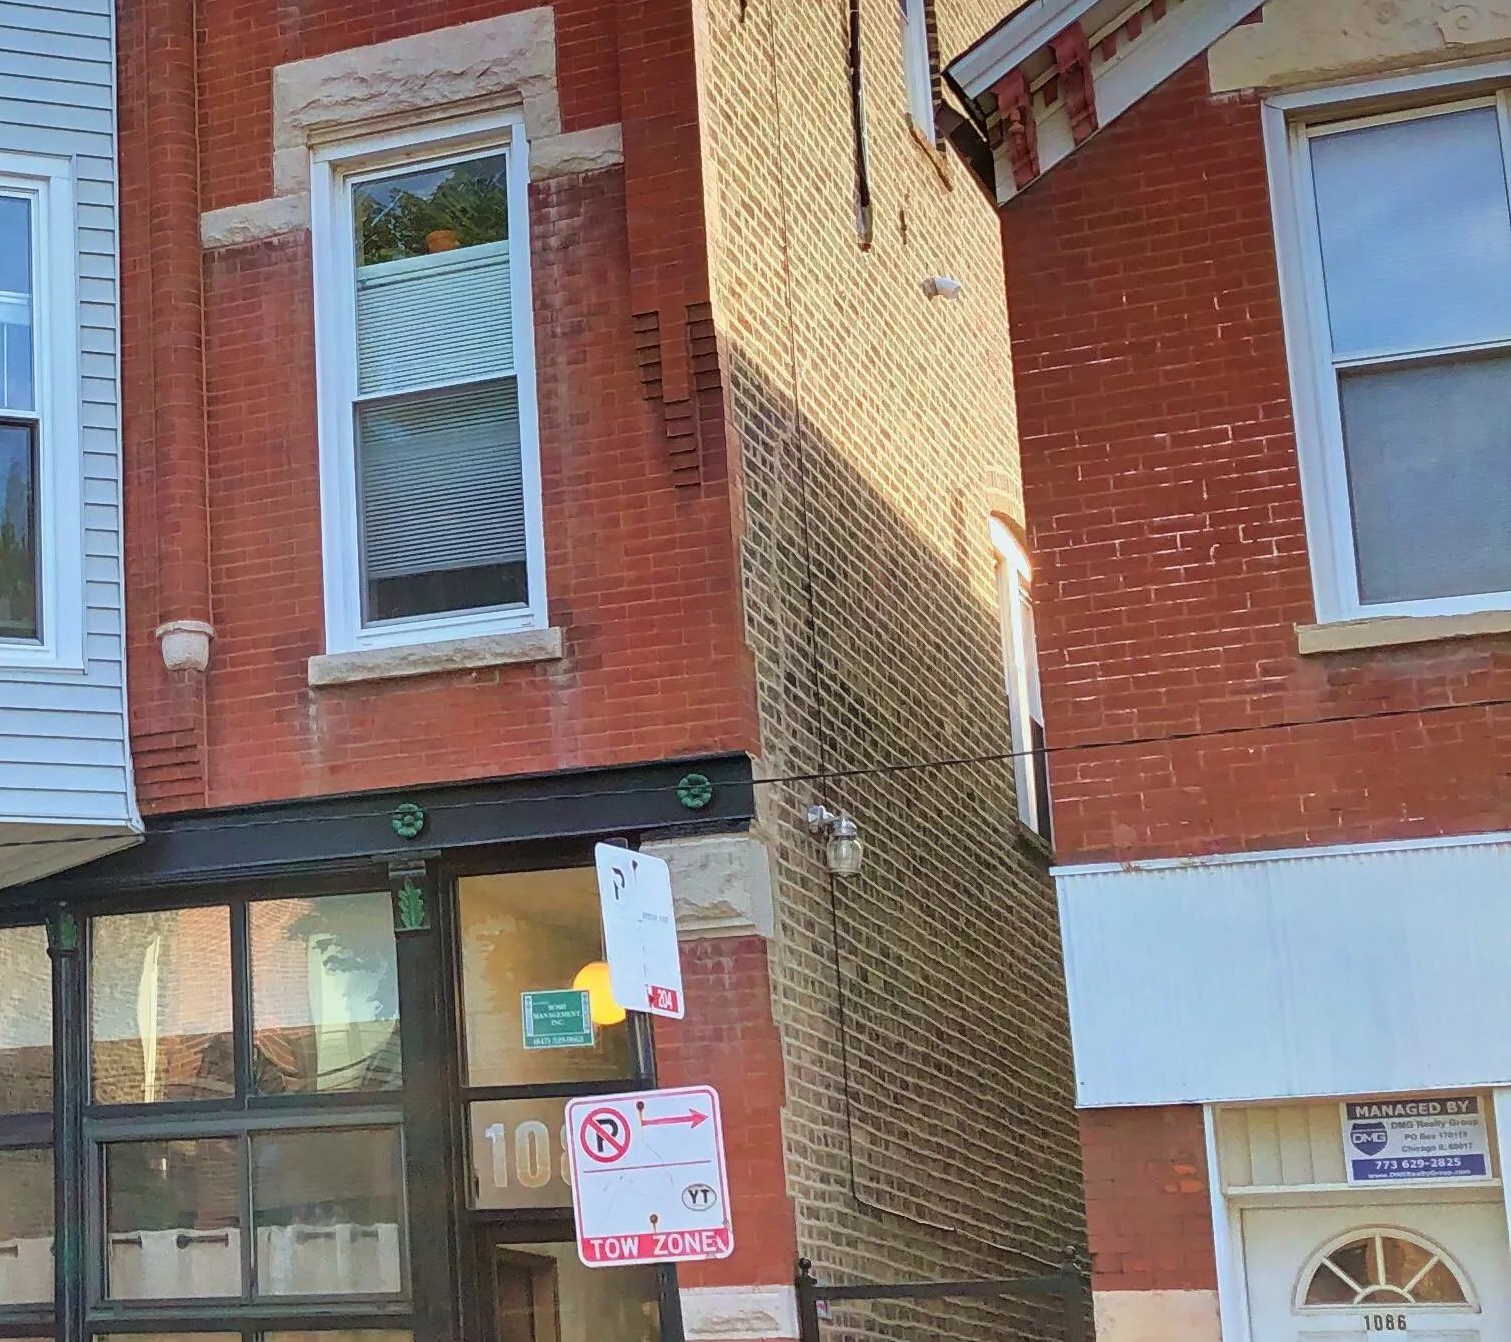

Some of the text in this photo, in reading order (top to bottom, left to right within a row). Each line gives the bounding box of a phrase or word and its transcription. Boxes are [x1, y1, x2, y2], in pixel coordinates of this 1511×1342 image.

[657, 989, 673, 1009] 204
[1355, 1099, 1470, 1118] MANAGED BY
[1391, 1118, 1478, 1129] DMG Realty Group
[1352, 1132, 1386, 1144] DMG
[1404, 1133, 1417, 1141] PO
[1375, 1157, 1462, 1170] 773 629-2825
[688, 1189, 710, 1205] YT
[590, 1231, 716, 1260] TOW ZONE
[1364, 1313, 1407, 1331] 1086
